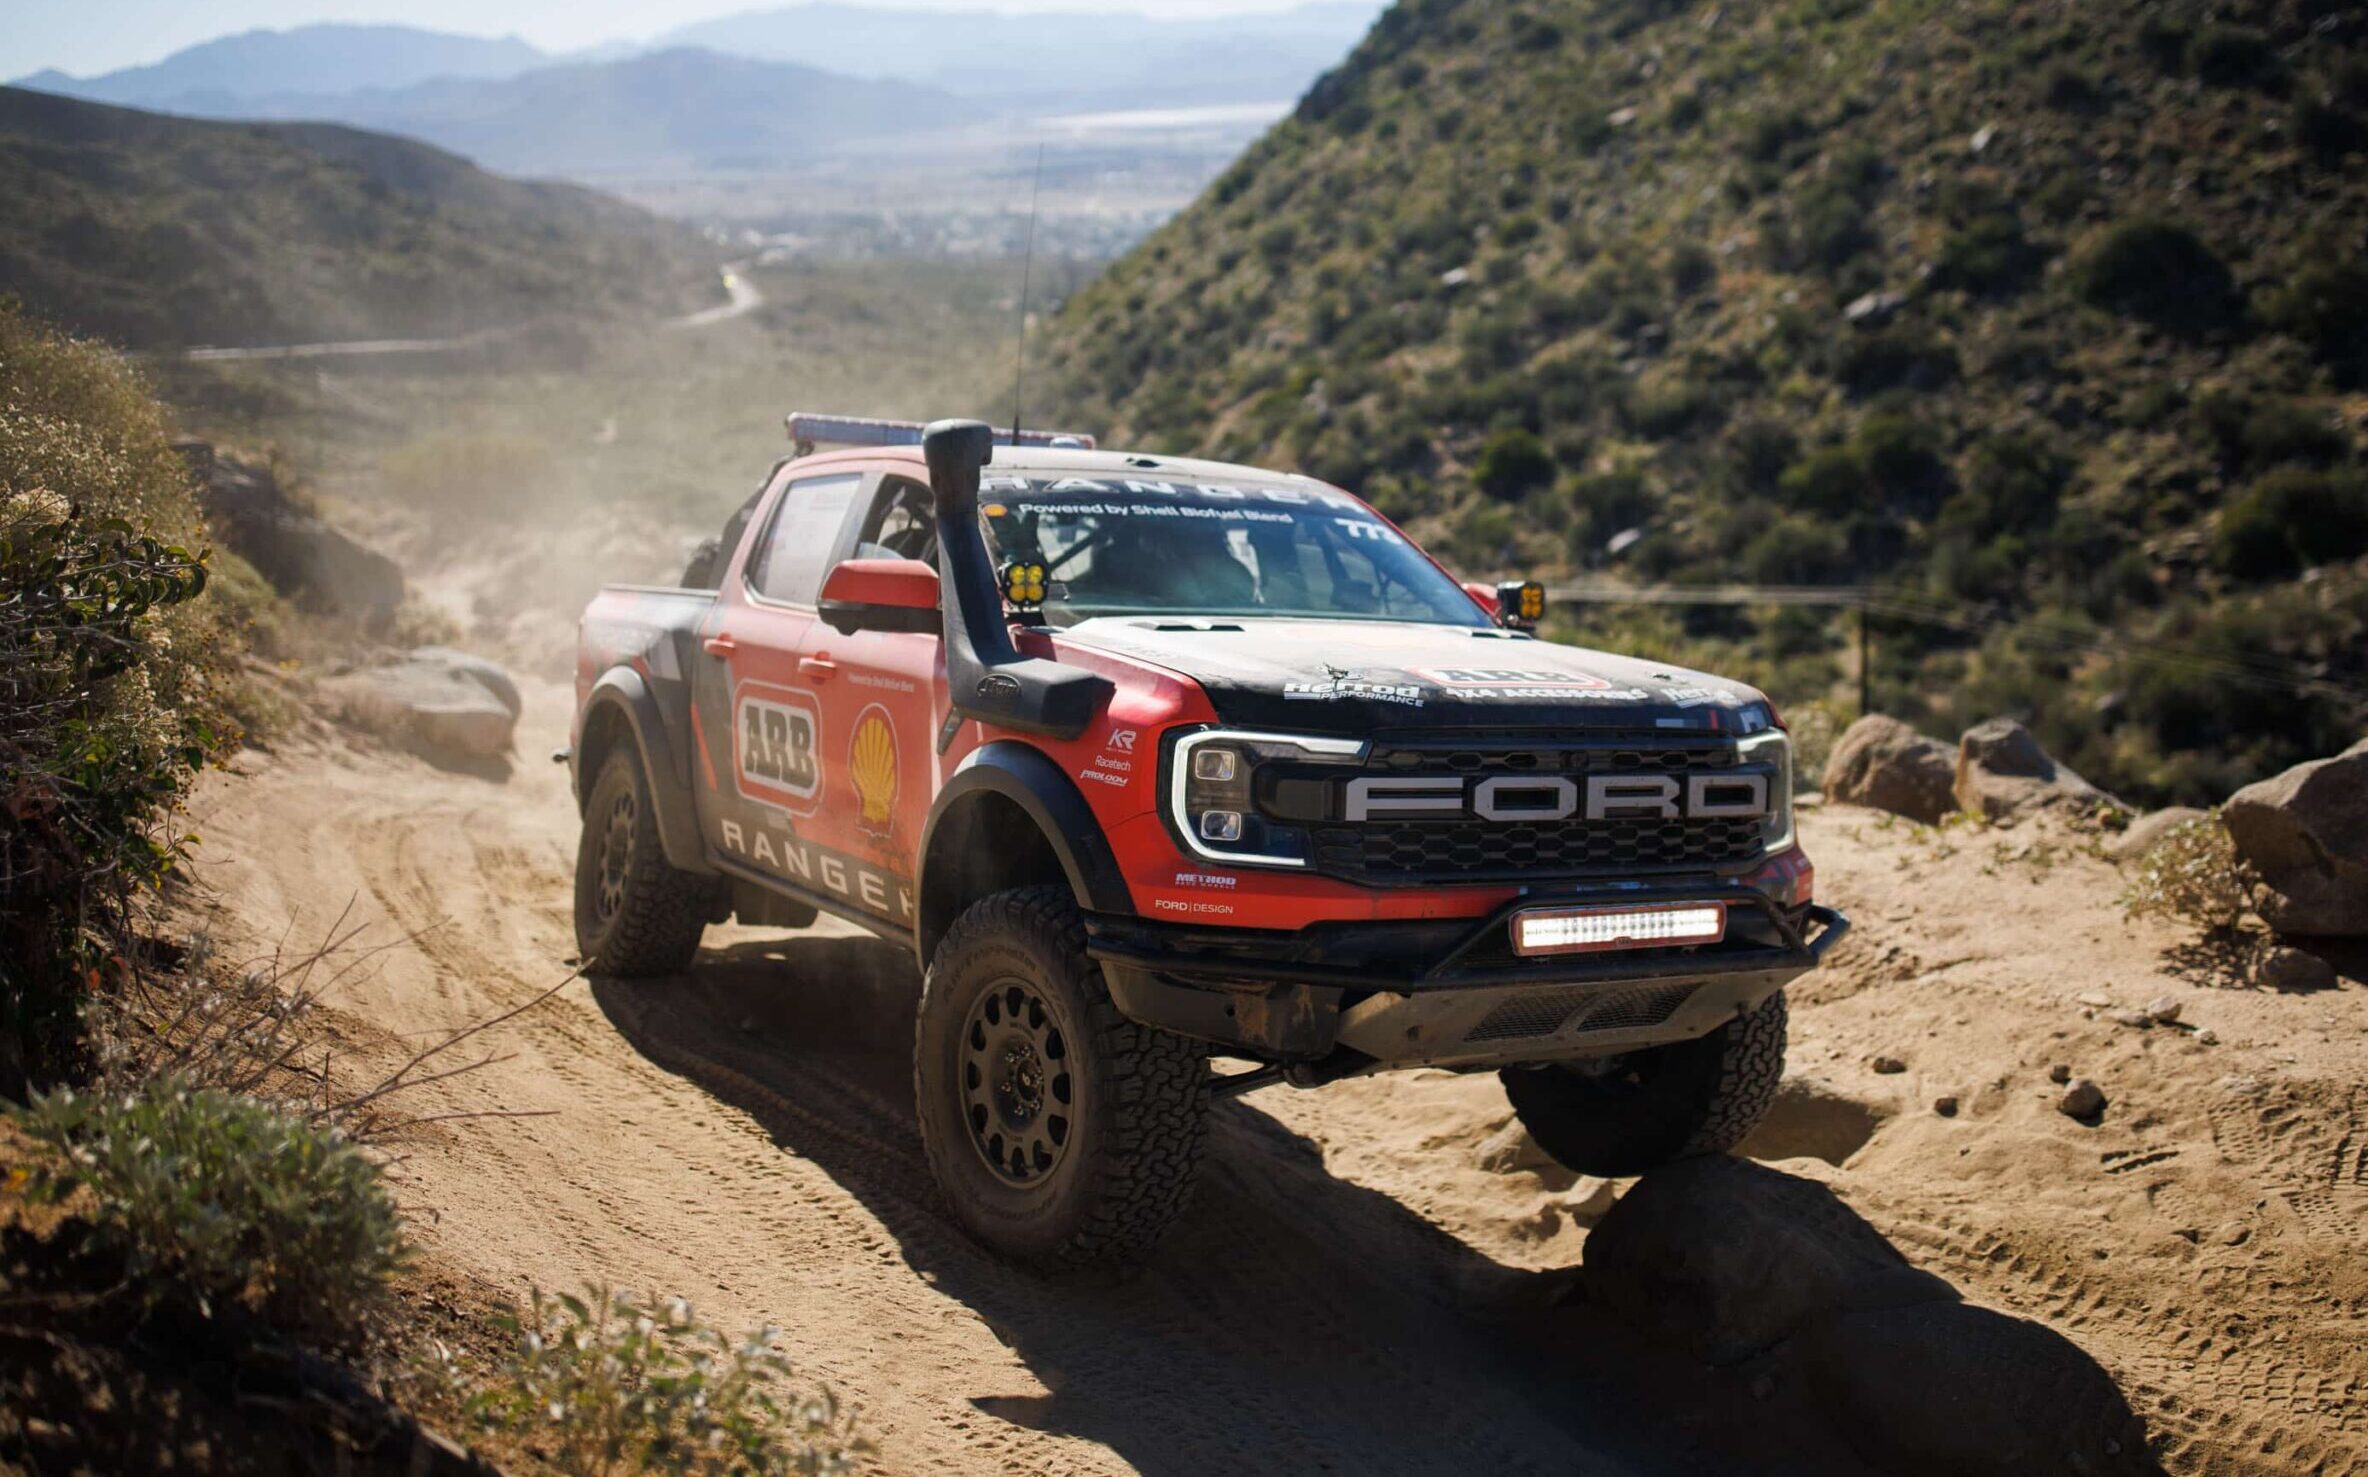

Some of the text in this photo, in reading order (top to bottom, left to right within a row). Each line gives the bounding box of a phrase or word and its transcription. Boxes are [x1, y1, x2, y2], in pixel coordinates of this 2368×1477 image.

[1018, 503, 1103, 515] Powered
[1104, 504, 1128, 517] by
[1131, 504, 1179, 517] Shell
[1244, 509, 1294, 524] Blend
[1284, 682, 1420, 699] Herrod
[1320, 690, 1424, 708] PERFORMANCE
[744, 703, 816, 790] ARB
[1108, 728, 1136, 750] KR
[1095, 755, 1131, 772] Racetech
[1346, 774, 1768, 822] FORD
[1176, 873, 1237, 886] METHOD
[1155, 899, 1234, 914] FORD DESIGN
